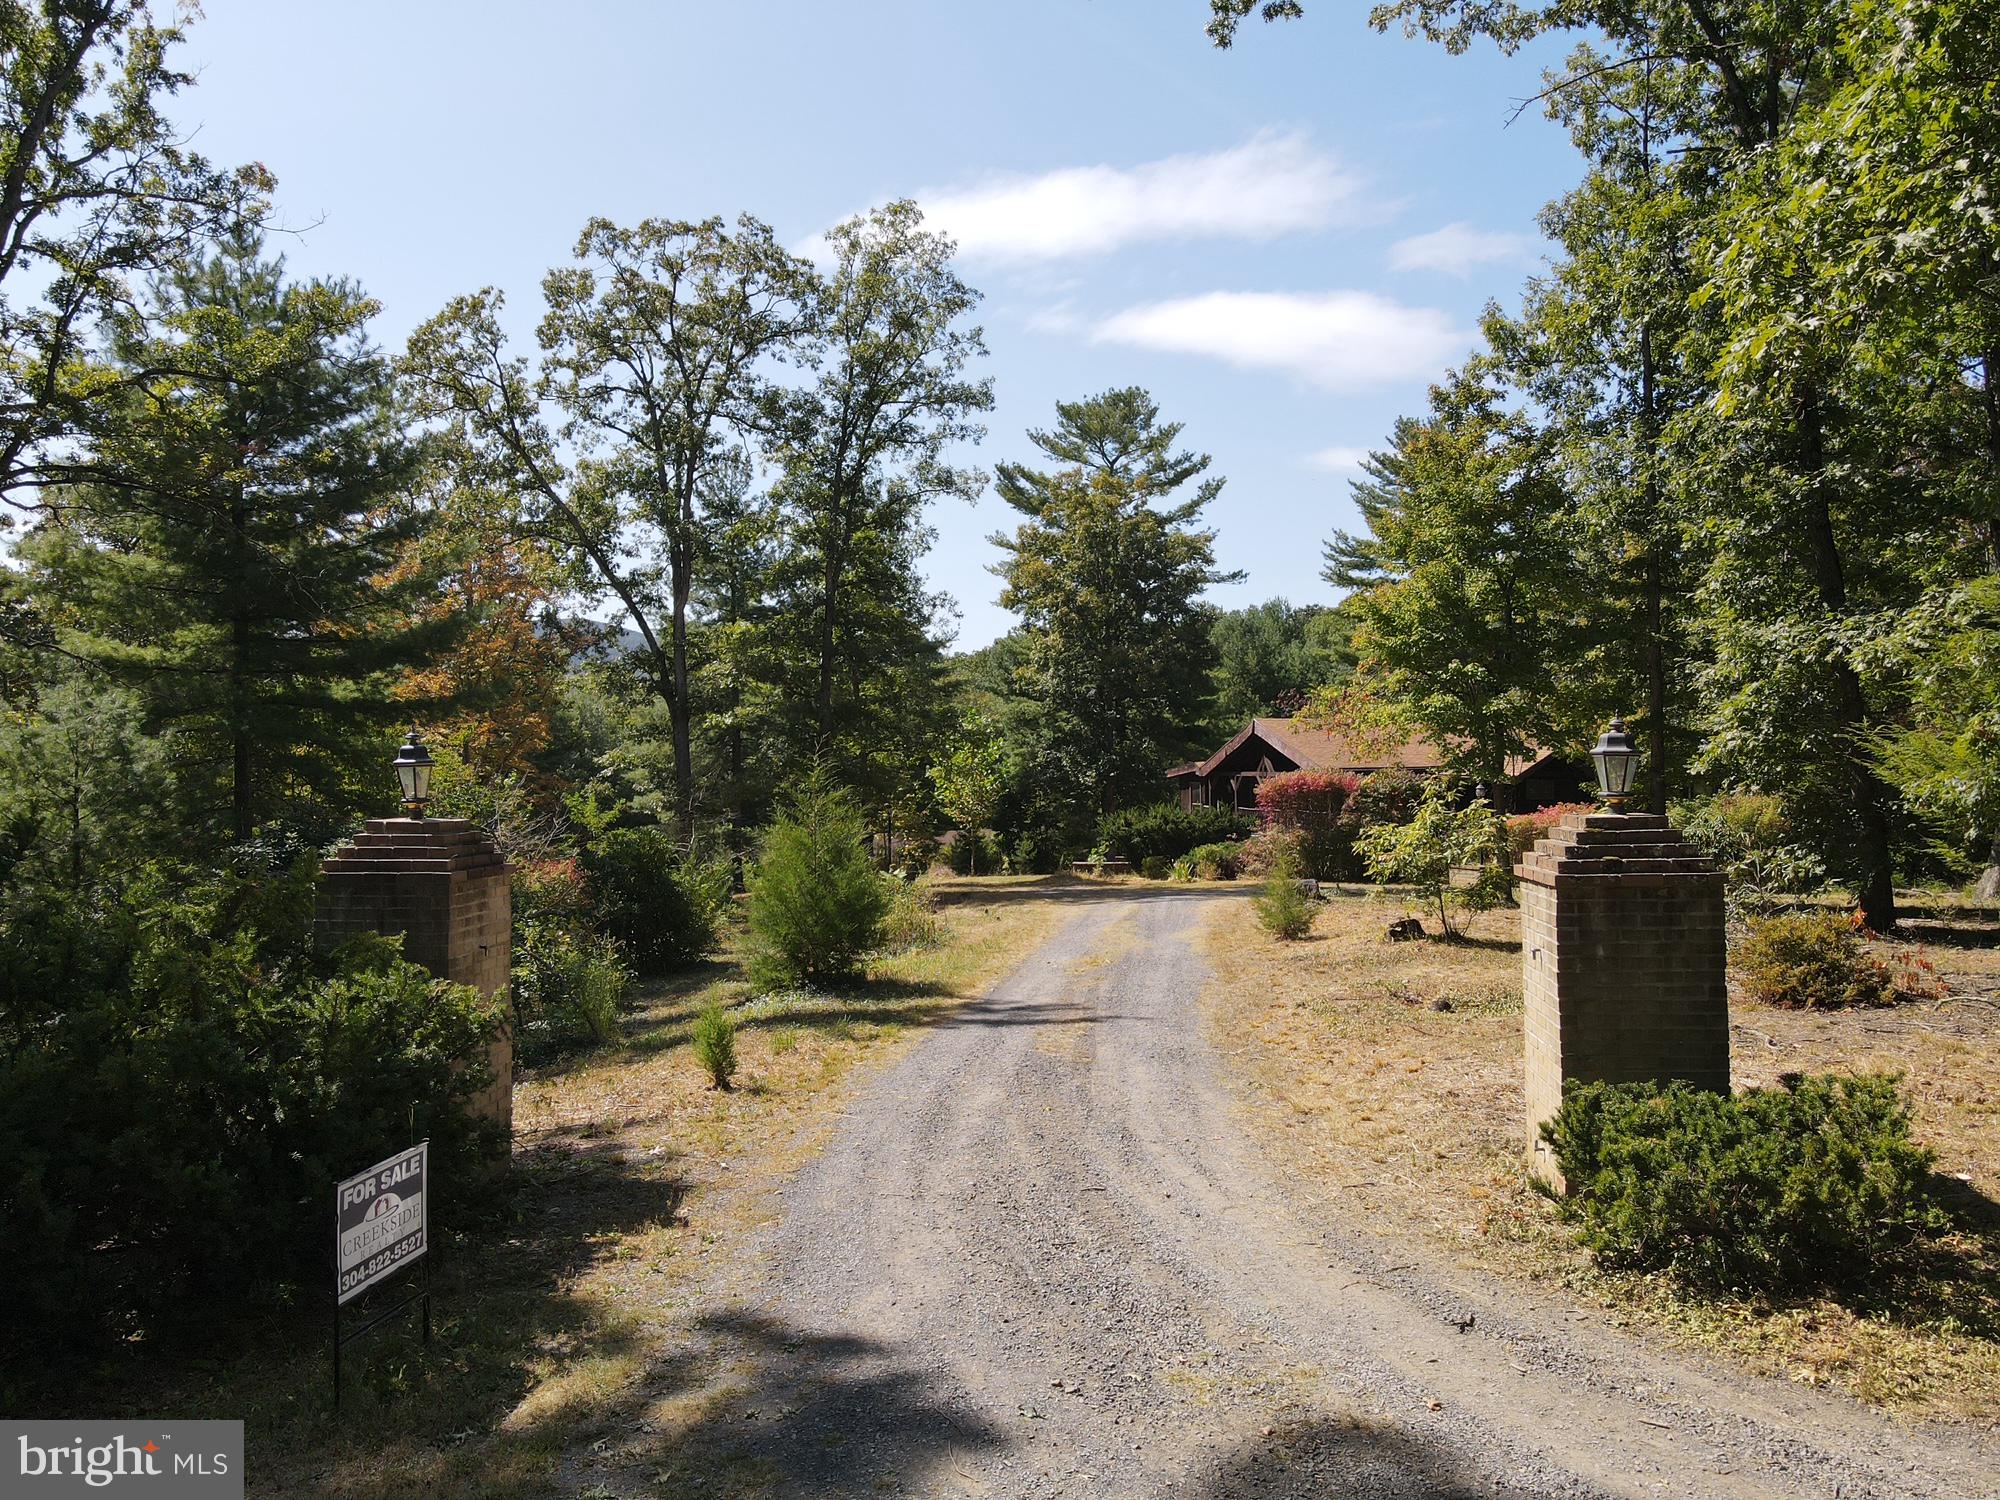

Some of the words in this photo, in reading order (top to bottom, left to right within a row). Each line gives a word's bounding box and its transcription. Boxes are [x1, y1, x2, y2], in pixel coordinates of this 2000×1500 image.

[343, 1177, 376, 1211] FOR
[381, 1154, 420, 1190] SALE
[343, 1202, 420, 1257] CREEKSIDE
[342, 1231, 422, 1291] 304-822-5527
